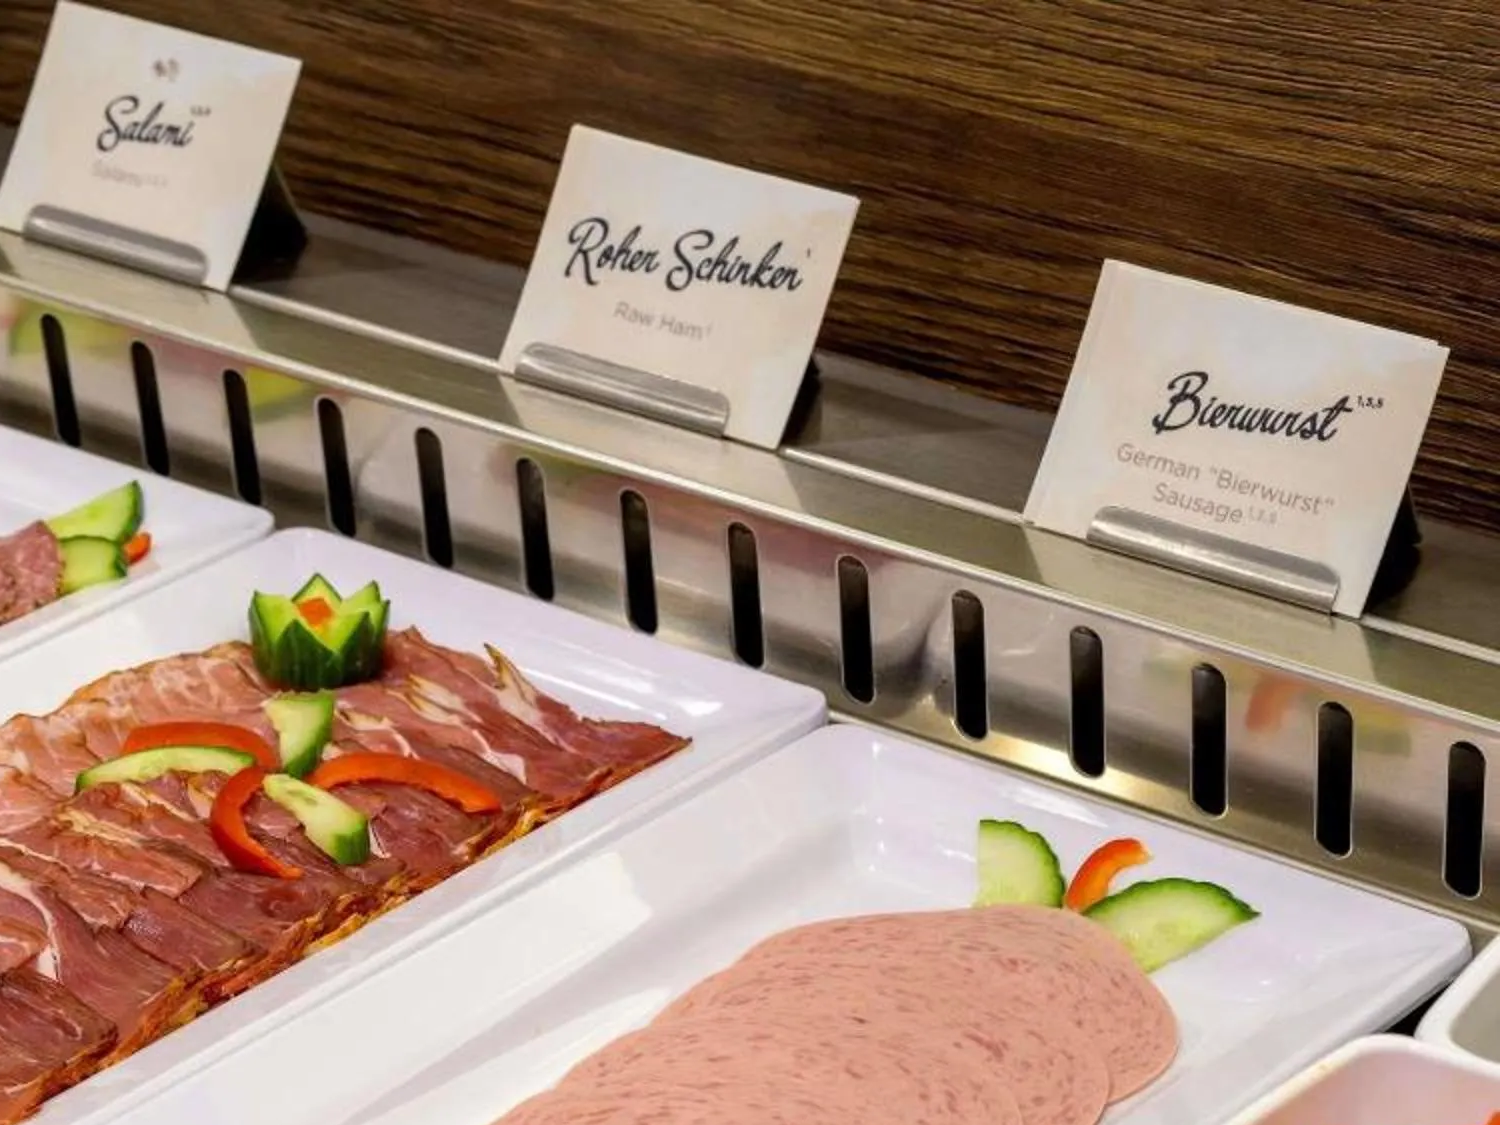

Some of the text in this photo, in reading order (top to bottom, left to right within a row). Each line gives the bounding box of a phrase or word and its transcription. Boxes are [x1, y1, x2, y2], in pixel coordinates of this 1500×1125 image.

[96, 95, 195, 152] Salami
[564, 217, 660, 286] Roher
[665, 230, 803, 291] Schinken
[612, 301, 656, 327] Raw
[657, 313, 703, 341] Ham
[1152, 371, 1354, 441] Bierwurst
[1116, 442, 1201, 482] German
[1153, 482, 1244, 525] Sausage
